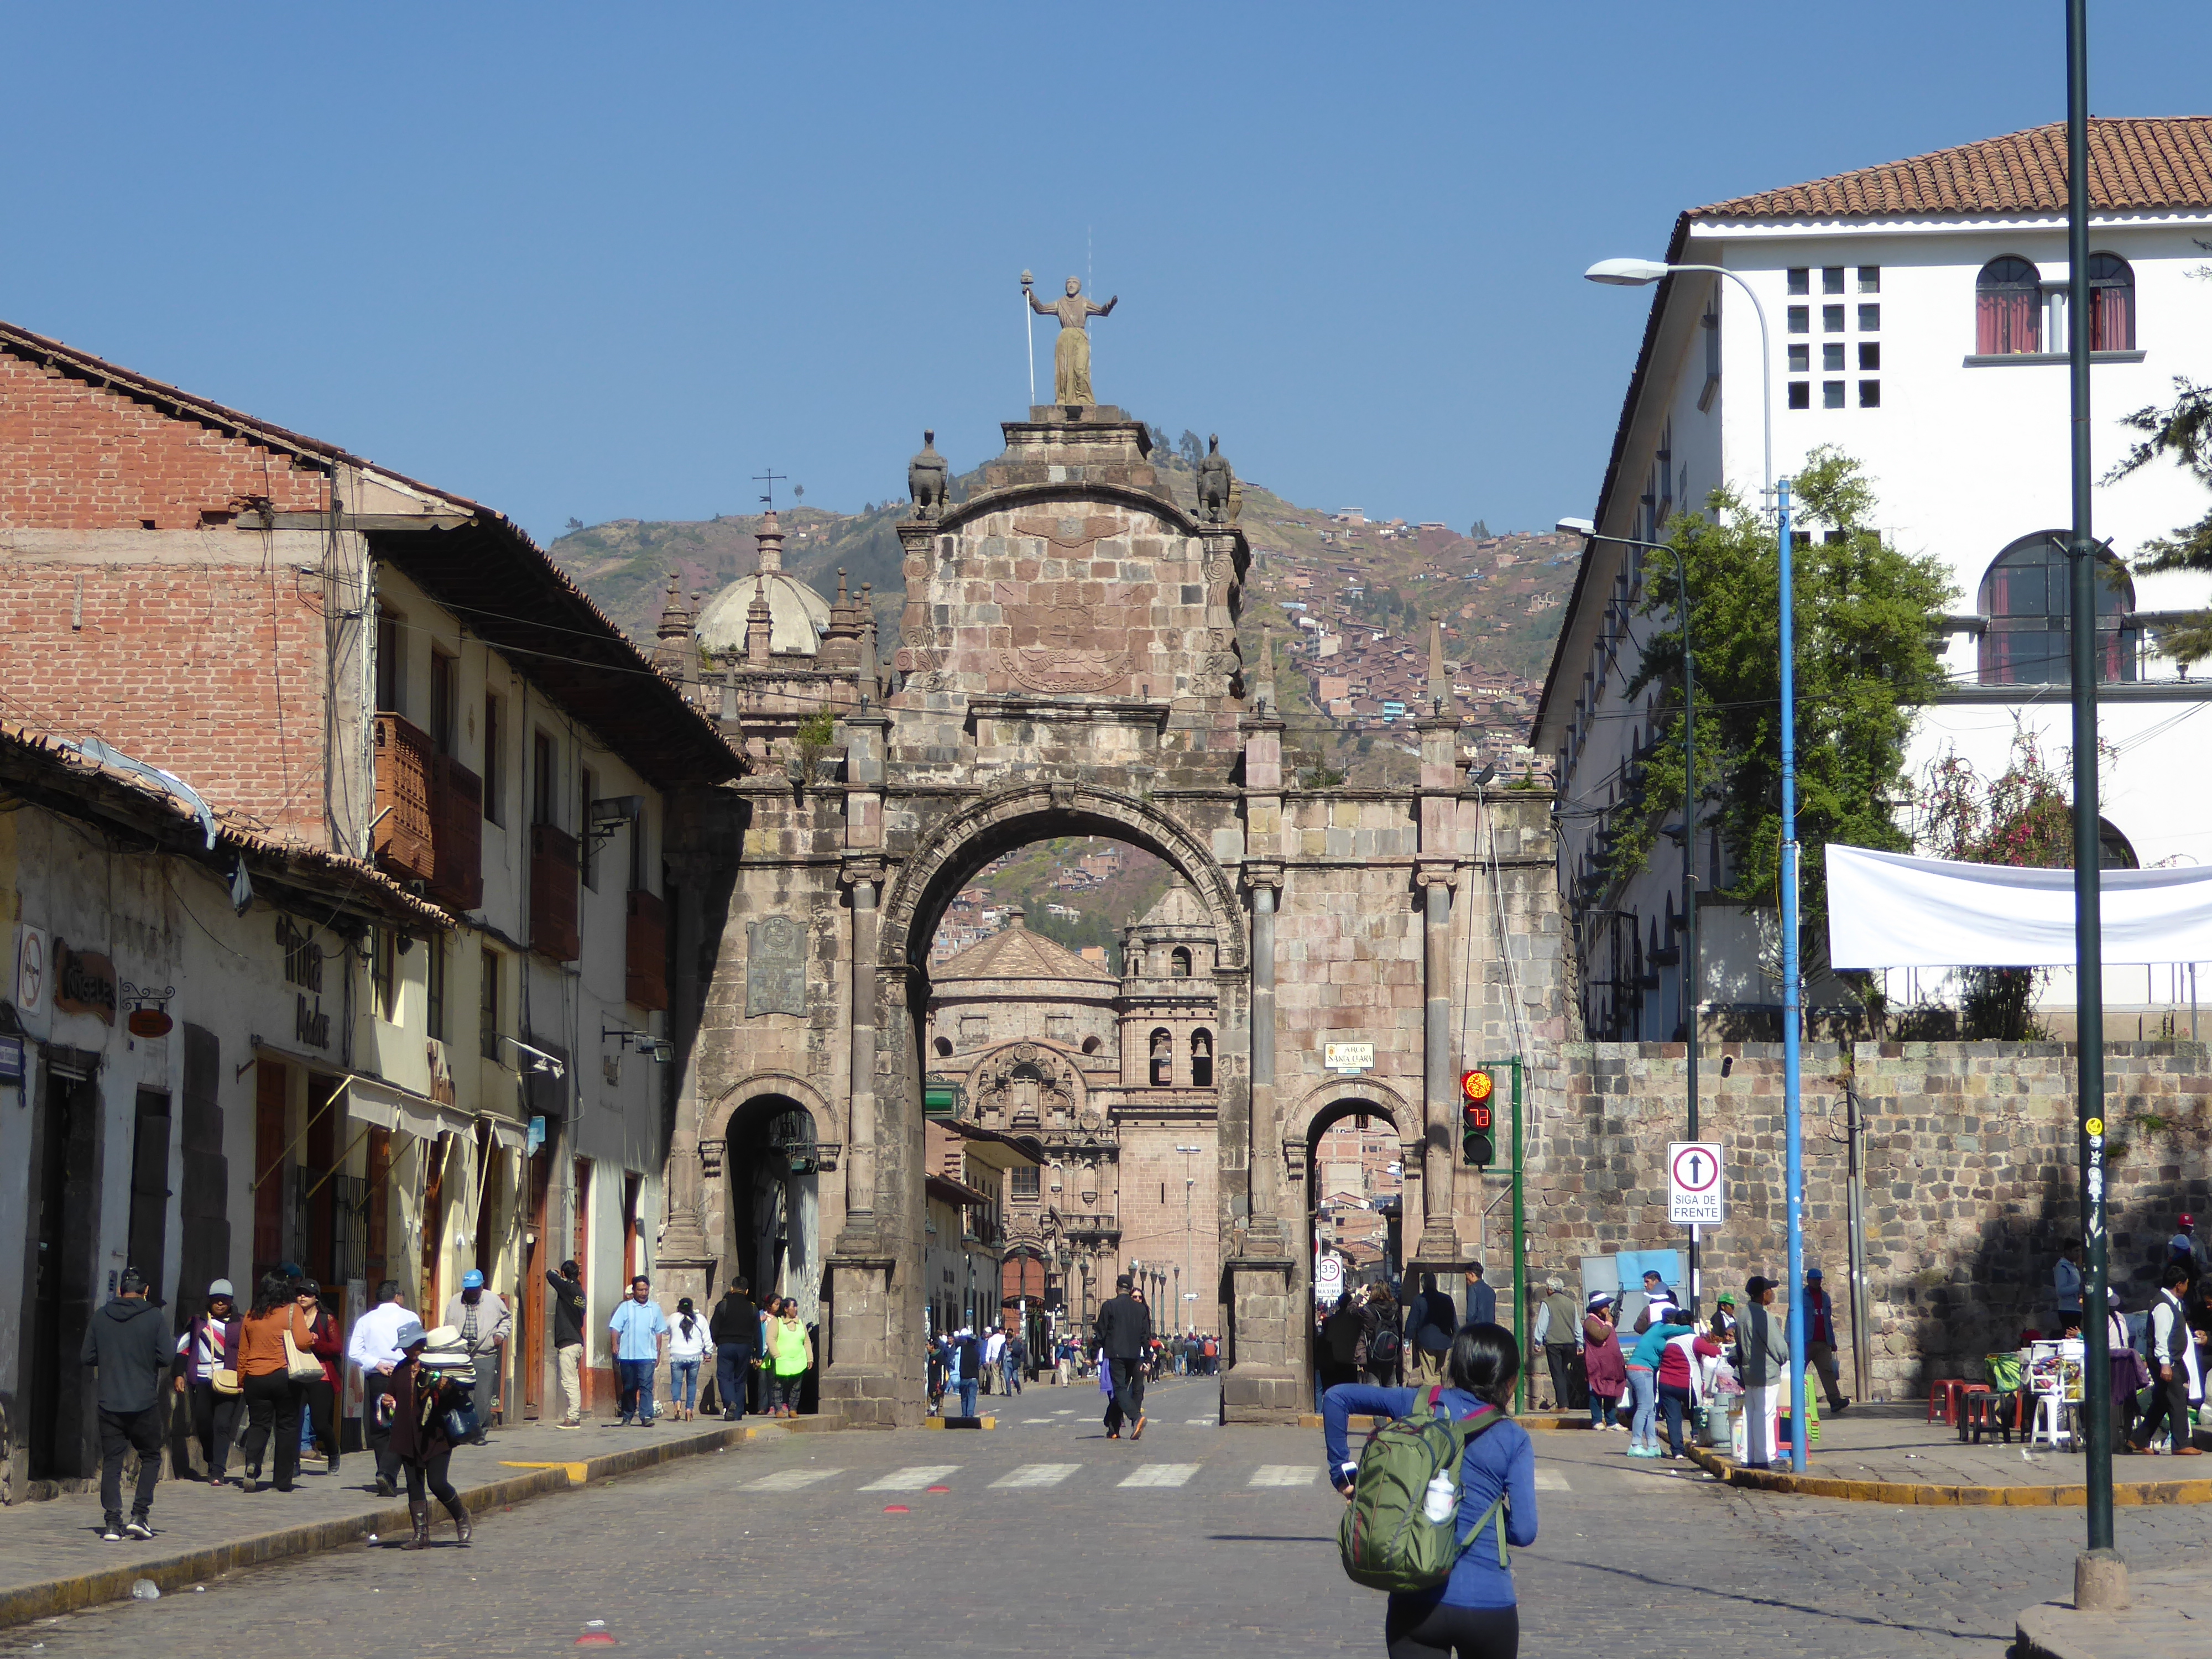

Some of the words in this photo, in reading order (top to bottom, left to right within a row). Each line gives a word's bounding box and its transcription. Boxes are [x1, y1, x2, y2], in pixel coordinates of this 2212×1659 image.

[1676, 1195, 1698, 1204] SIGA
[1703, 1195, 1716, 1205] DE
[1674, 1208, 1718, 1217] FRENTE
[1322, 1265, 1335, 1273] 35
